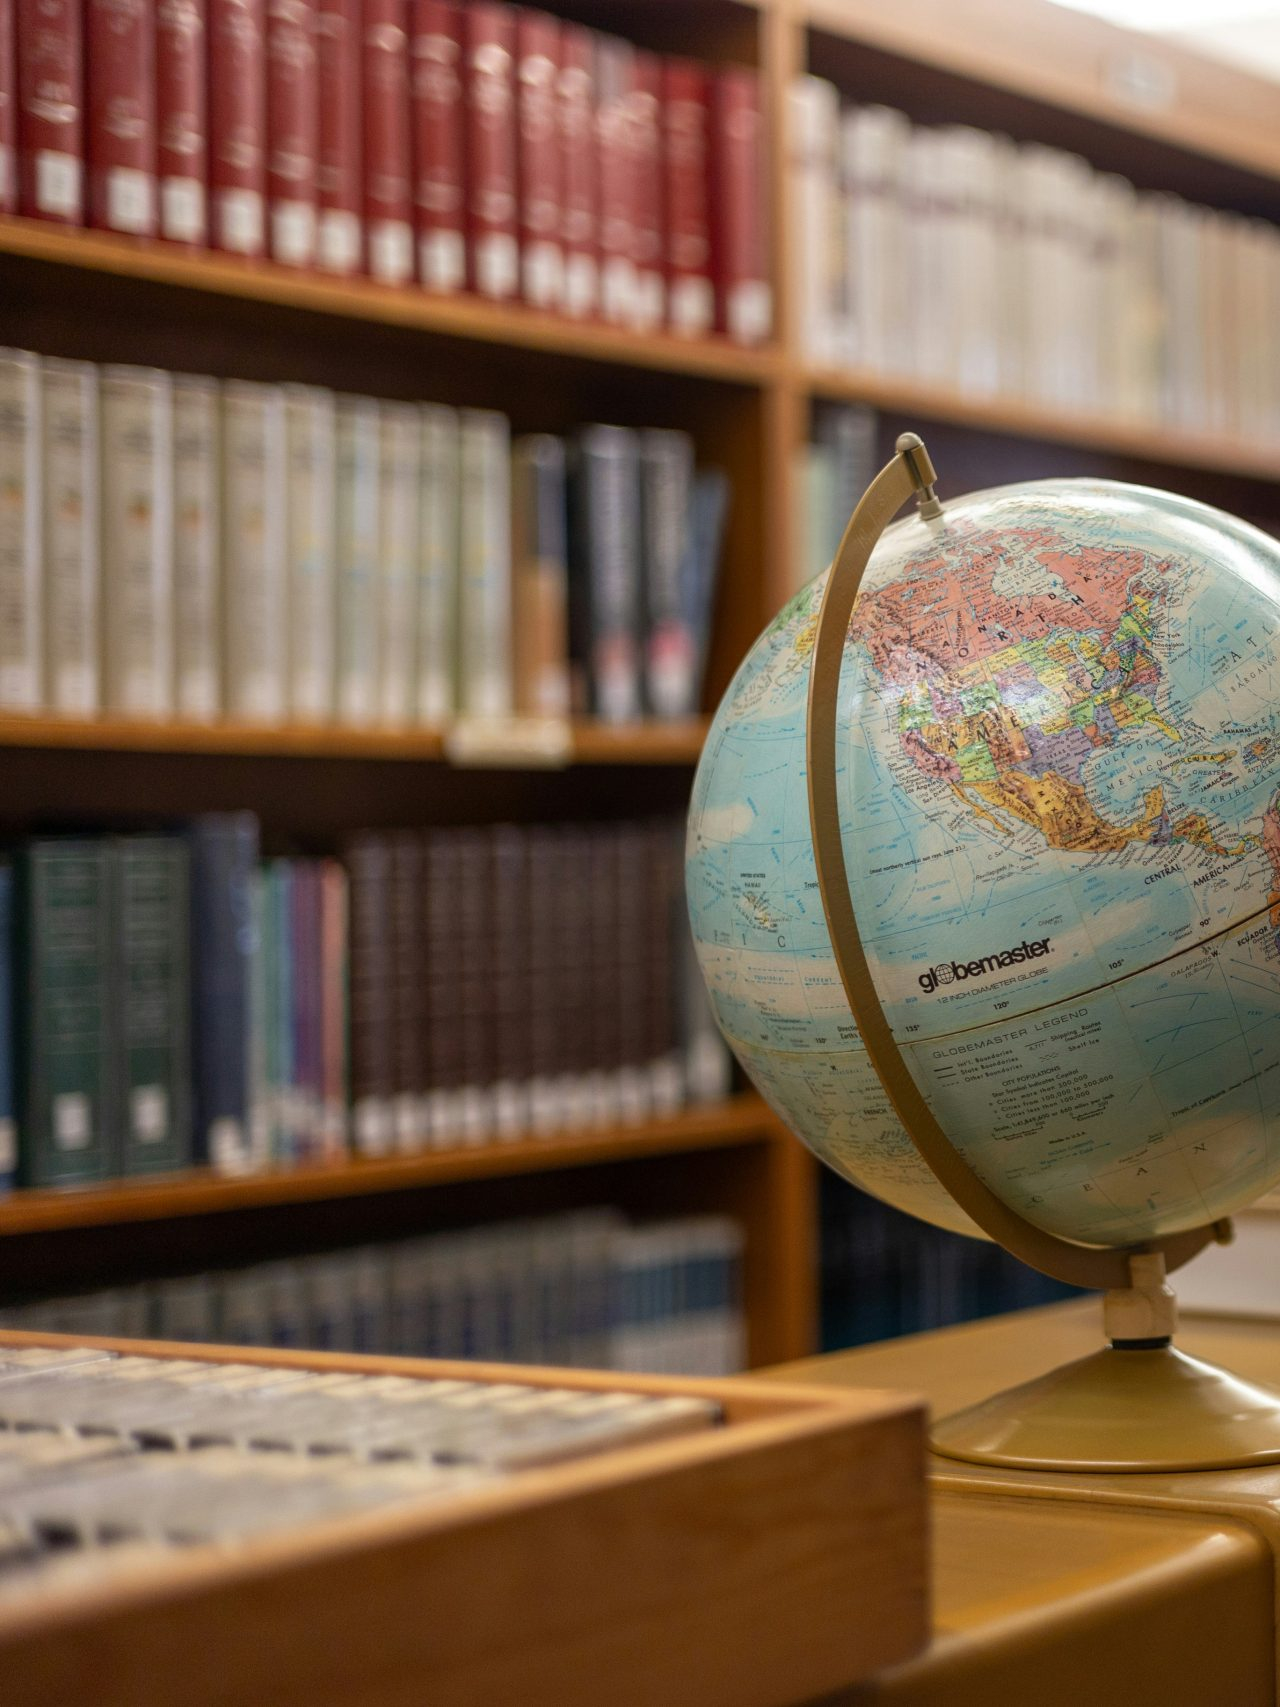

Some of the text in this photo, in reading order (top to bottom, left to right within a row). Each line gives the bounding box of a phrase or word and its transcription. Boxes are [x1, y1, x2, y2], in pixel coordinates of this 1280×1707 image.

[980, 603, 1020, 624] MANITOBA
[1223, 727, 1251, 735] BAHAMAS
[1187, 755, 1215, 764] CUBA
[1106, 759, 1163, 792] MEXICO
[1200, 777, 1224, 793] JAMAICA
[1167, 802, 1185, 815] BELIZE
[1144, 864, 1181, 885] CENTRAL
[1193, 864, 1229, 888] AMERICA
[1199, 917, 1211, 928] 90°
[1236, 926, 1269, 947] ECUADOR
[1108, 959, 1125, 971] 105°
[1170, 955, 1212, 977] GALAPAGOS
[937, 967, 1049, 1004] 12 INCH DIAMETER GLOBE
[993, 1001, 1010, 1011] 120°
[837, 1025, 857, 1033] Directio
[932, 1008, 1088, 1060] GLOBEMASTER LEGEND
[1050, 1029, 1078, 1042] Shipping
[975, 1049, 1013, 1063] Boundaries
[1068, 1041, 1087, 1052] Shelf
[960, 1056, 1018, 1075] State Boundaries
[964, 1063, 1023, 1082] Other Boundaries
[1002, 1065, 1061, 1087] CITY POPULATIONS
[996, 1097, 1016, 1105] Cities
[1039, 1085, 1056, 1094] than
[1000, 1104, 1021, 1112] Cities
[1041, 1088, 1071, 1102] 100,000
[1005, 1111, 1026, 1119] Cities
[1027, 1106, 1041, 1114] less
[1060, 1090, 1090, 1104] 100,000
[1171, 1106, 1191, 1118] Tropic
